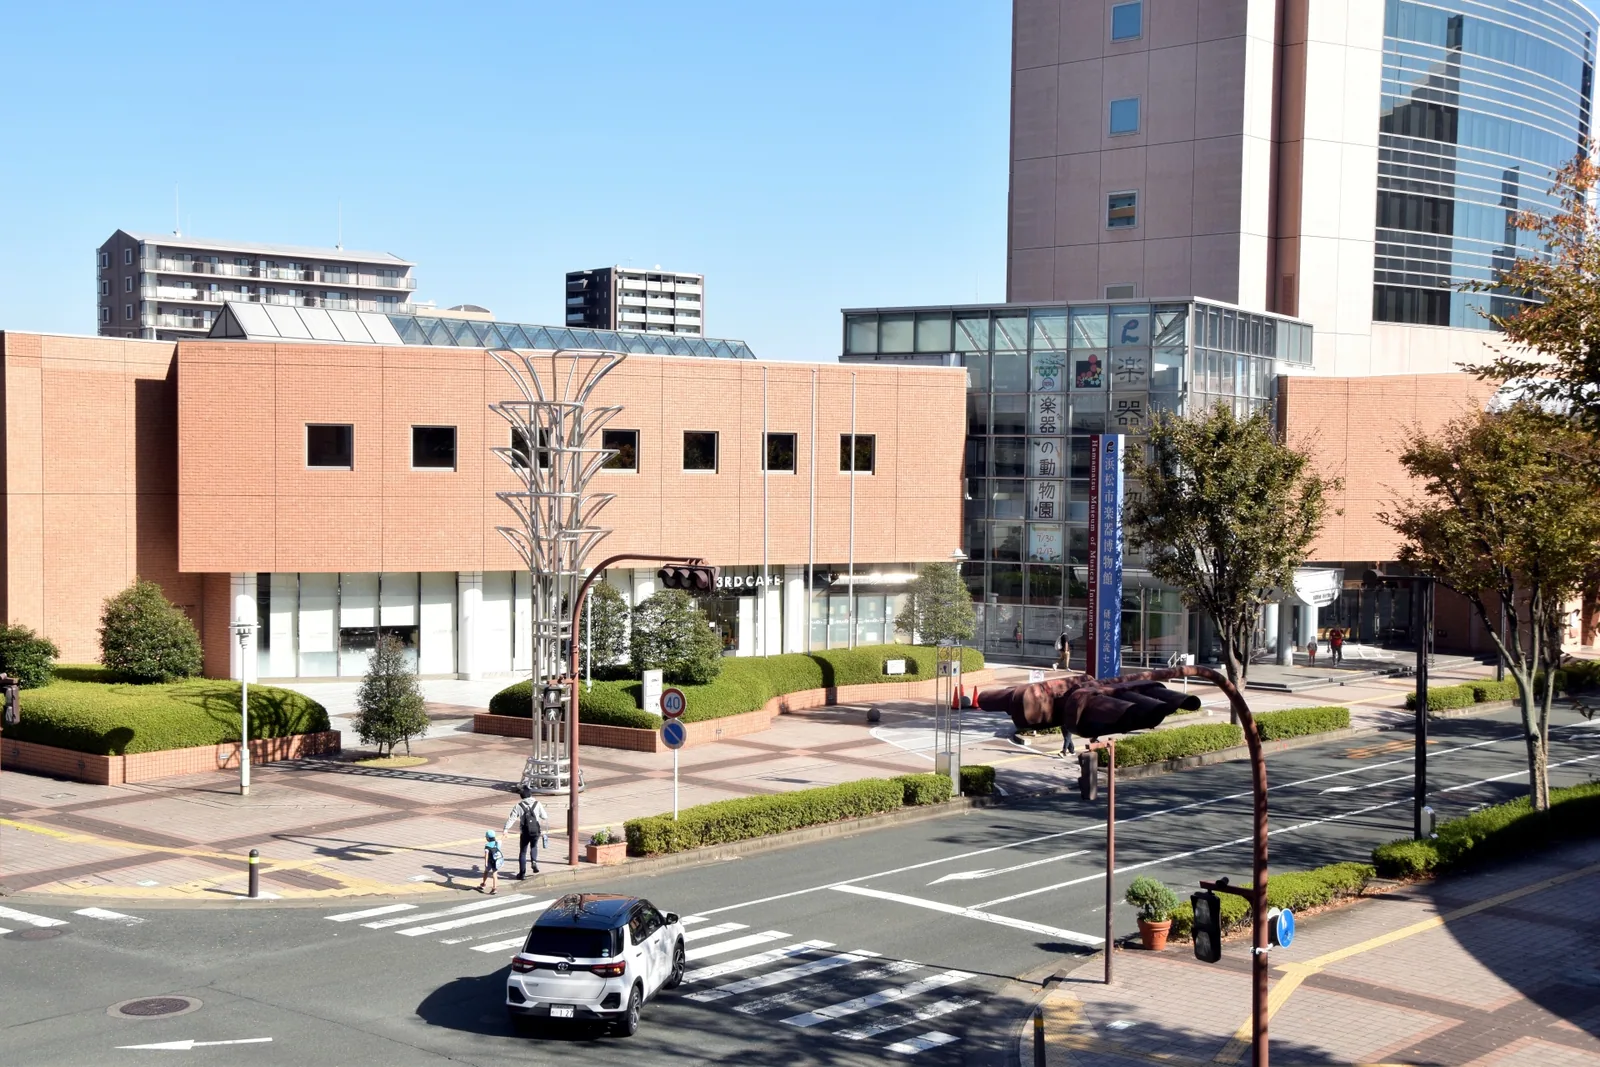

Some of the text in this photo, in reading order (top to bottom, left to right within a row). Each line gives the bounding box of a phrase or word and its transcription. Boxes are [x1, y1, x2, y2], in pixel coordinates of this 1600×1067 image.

[1039, 396, 1057, 519] 楽器の動物園
[1090, 440, 1098, 490] Hamamatsu
[1090, 536, 1097, 545] of
[716, 576, 743, 588] 3RD
[1089, 550, 1097, 584] Musical
[1102, 457, 1115, 679] 浜松市楽器博物館 研修交流セン
[1088, 589, 1096, 640] Instruments
[666, 696, 680, 710] 40
